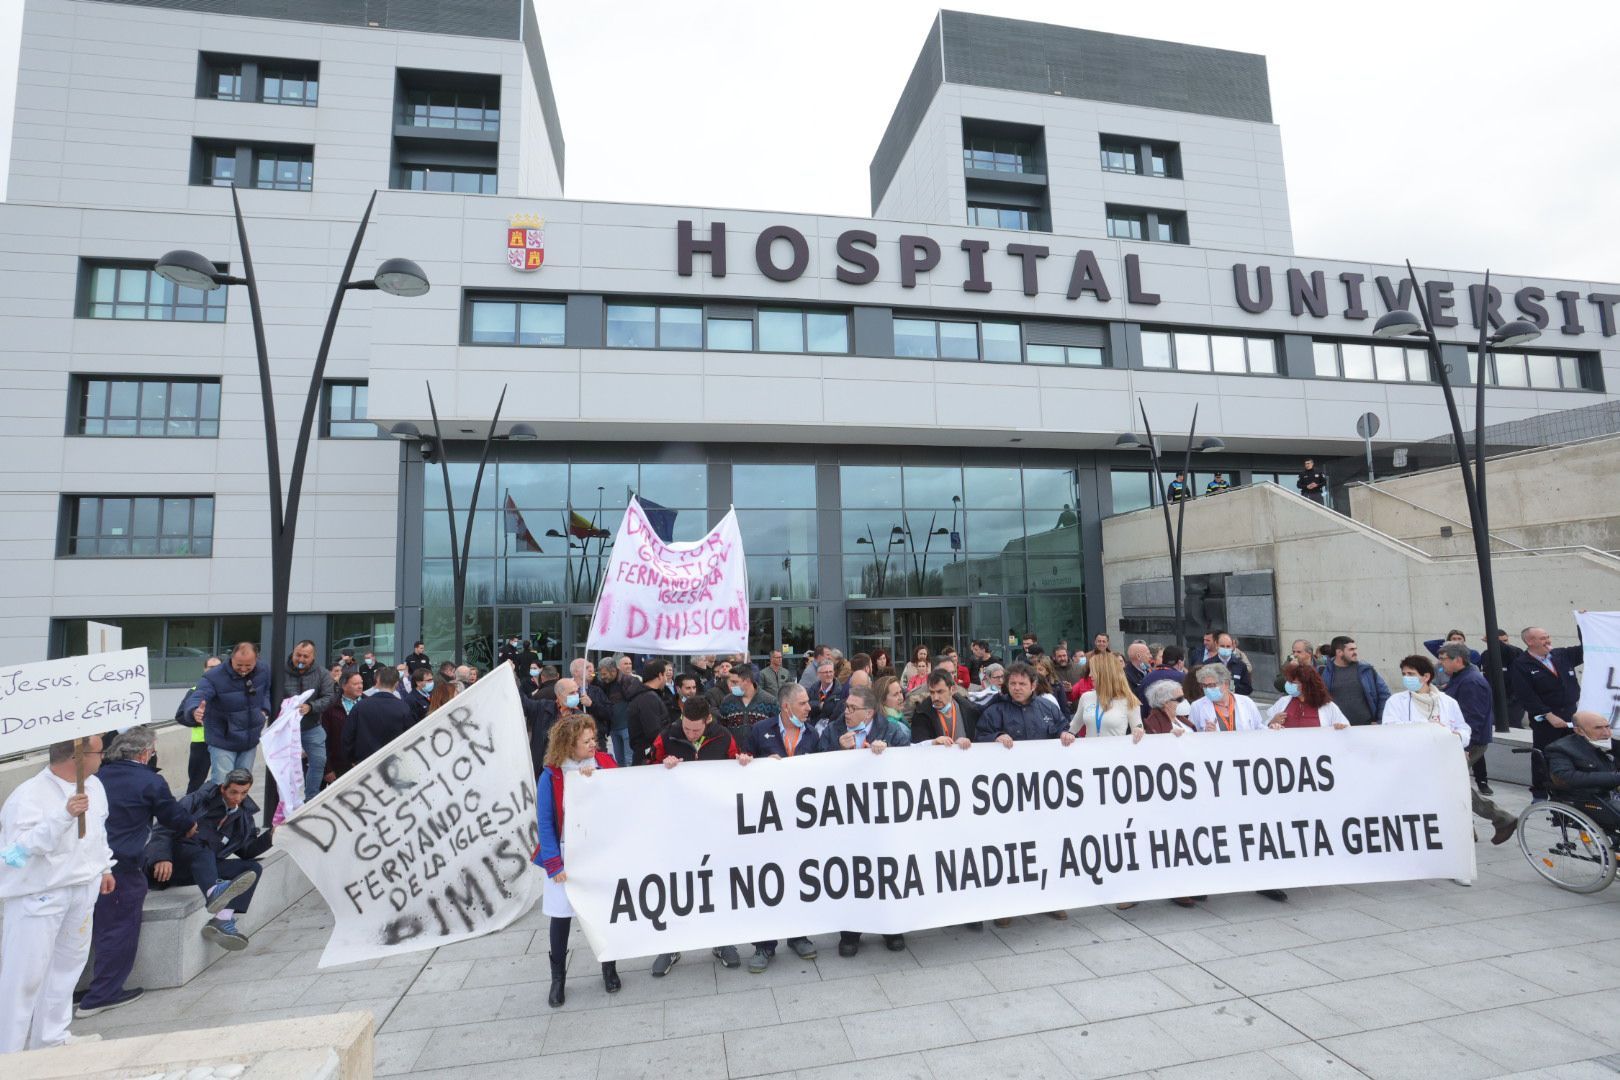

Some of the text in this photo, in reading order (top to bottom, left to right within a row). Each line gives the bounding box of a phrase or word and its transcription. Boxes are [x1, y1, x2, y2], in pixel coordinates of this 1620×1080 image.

[677, 219, 1161, 306] HOSPITAL
[344, 788, 481, 915] FERNANDO
[354, 723, 495, 861] GESTION
[389, 780, 535, 912] DE LA IGLESIA
[737, 754, 1335, 835] LA SANIDAD SOMOS TODOS Y TODAS
[609, 813, 1444, 931] AQUÍ NO SOBRA NADIE, AQUÍ HACE FALTA GENTE
